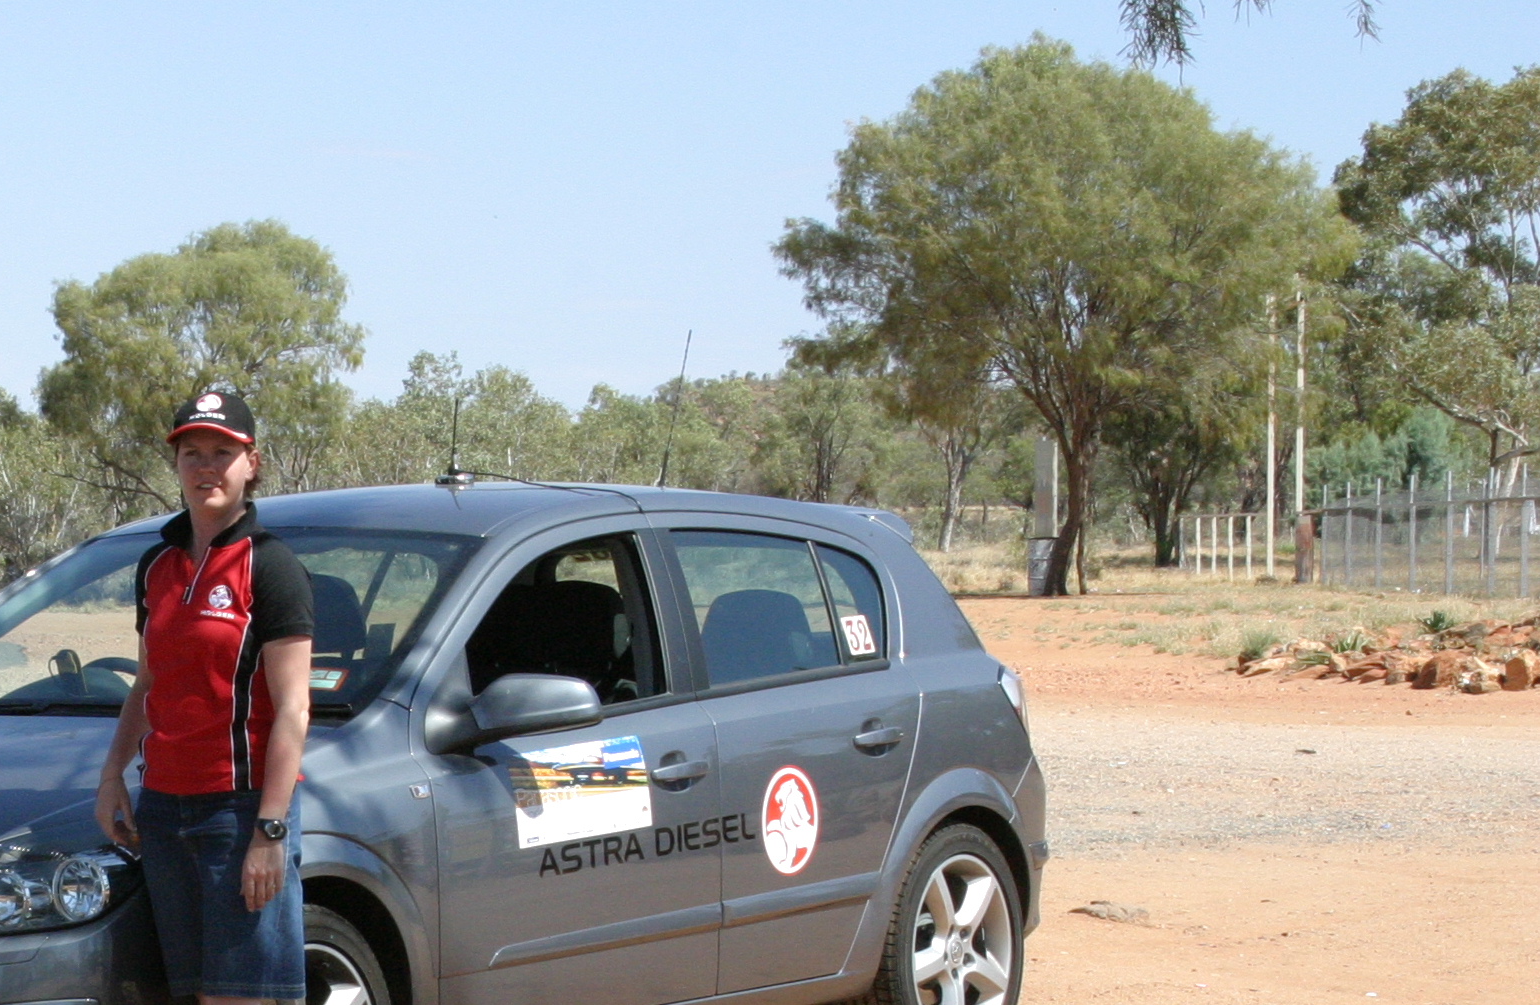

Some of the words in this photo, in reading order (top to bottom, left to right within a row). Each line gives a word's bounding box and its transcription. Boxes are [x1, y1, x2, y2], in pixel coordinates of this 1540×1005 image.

[200, 610, 235, 620] HOLDEN
[845, 619, 872, 651] 32
[539, 833, 644, 878] ASTRA
[655, 813, 756, 857] DIESEL
